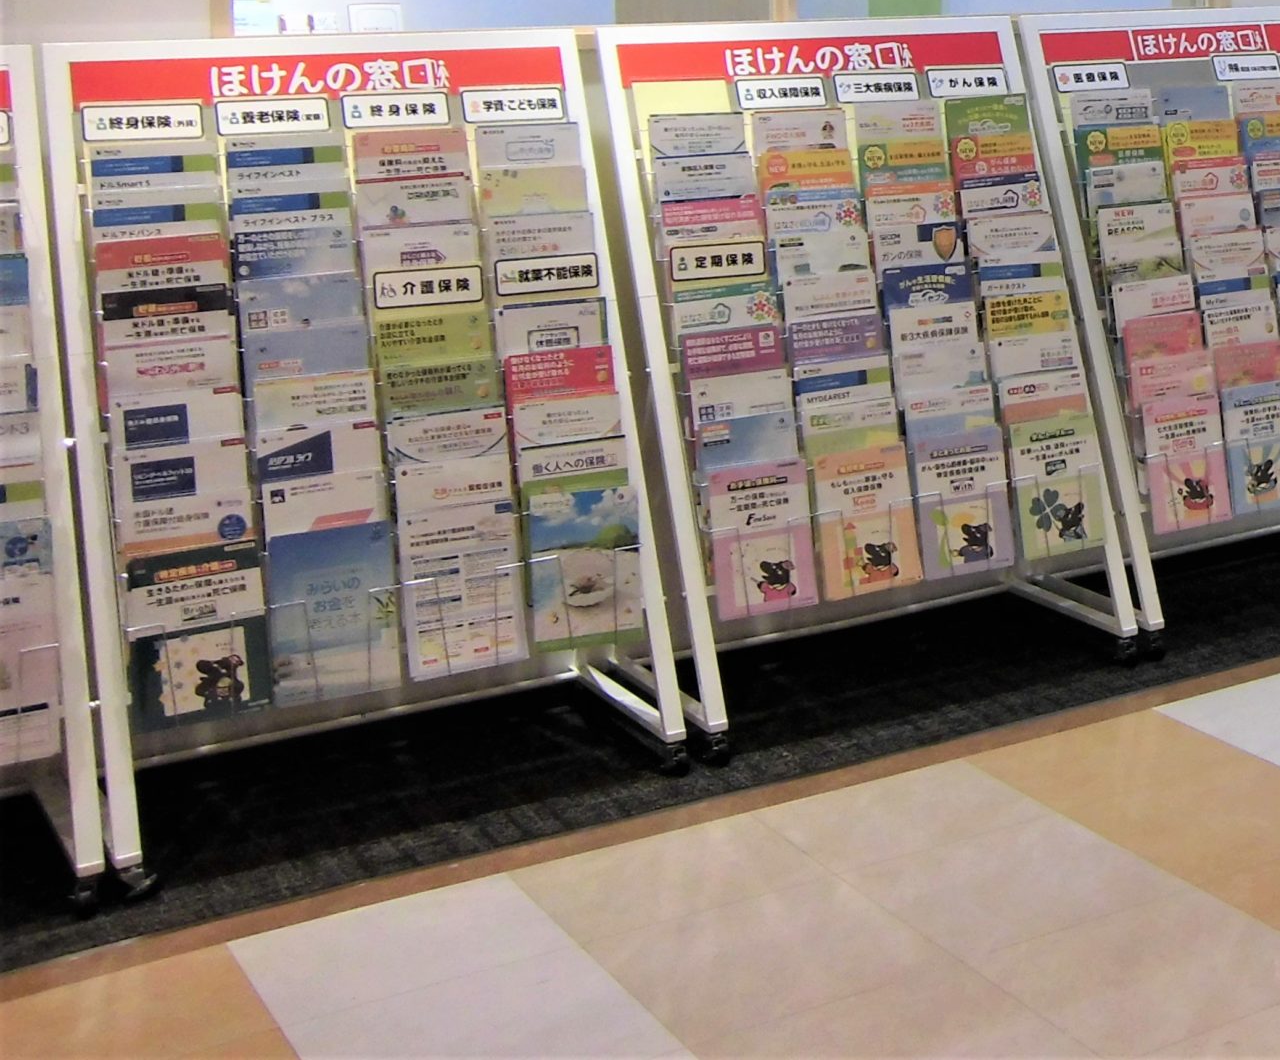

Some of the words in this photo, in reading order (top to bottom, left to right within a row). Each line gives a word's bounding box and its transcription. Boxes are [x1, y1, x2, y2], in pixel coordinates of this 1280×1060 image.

[1138, 31, 1263, 56] ほけんの窓口
[724, 42, 913, 76] ほけんの窓口
[210, 58, 450, 96] ほけんの窓口
[949, 76, 1000, 89] がん保険
[1073, 71, 1120, 83] 医療保険
[757, 87, 821, 100] 収入保障保険
[853, 81, 914, 94] 三大疾病保険
[369, 102, 437, 117] 終身保険
[694, 252, 754, 269] 定期保険
[518, 264, 593, 282] 就業不能保険
[402, 277, 471, 295] 介護保険
[806, 391, 850, 404] MYDEAREST
